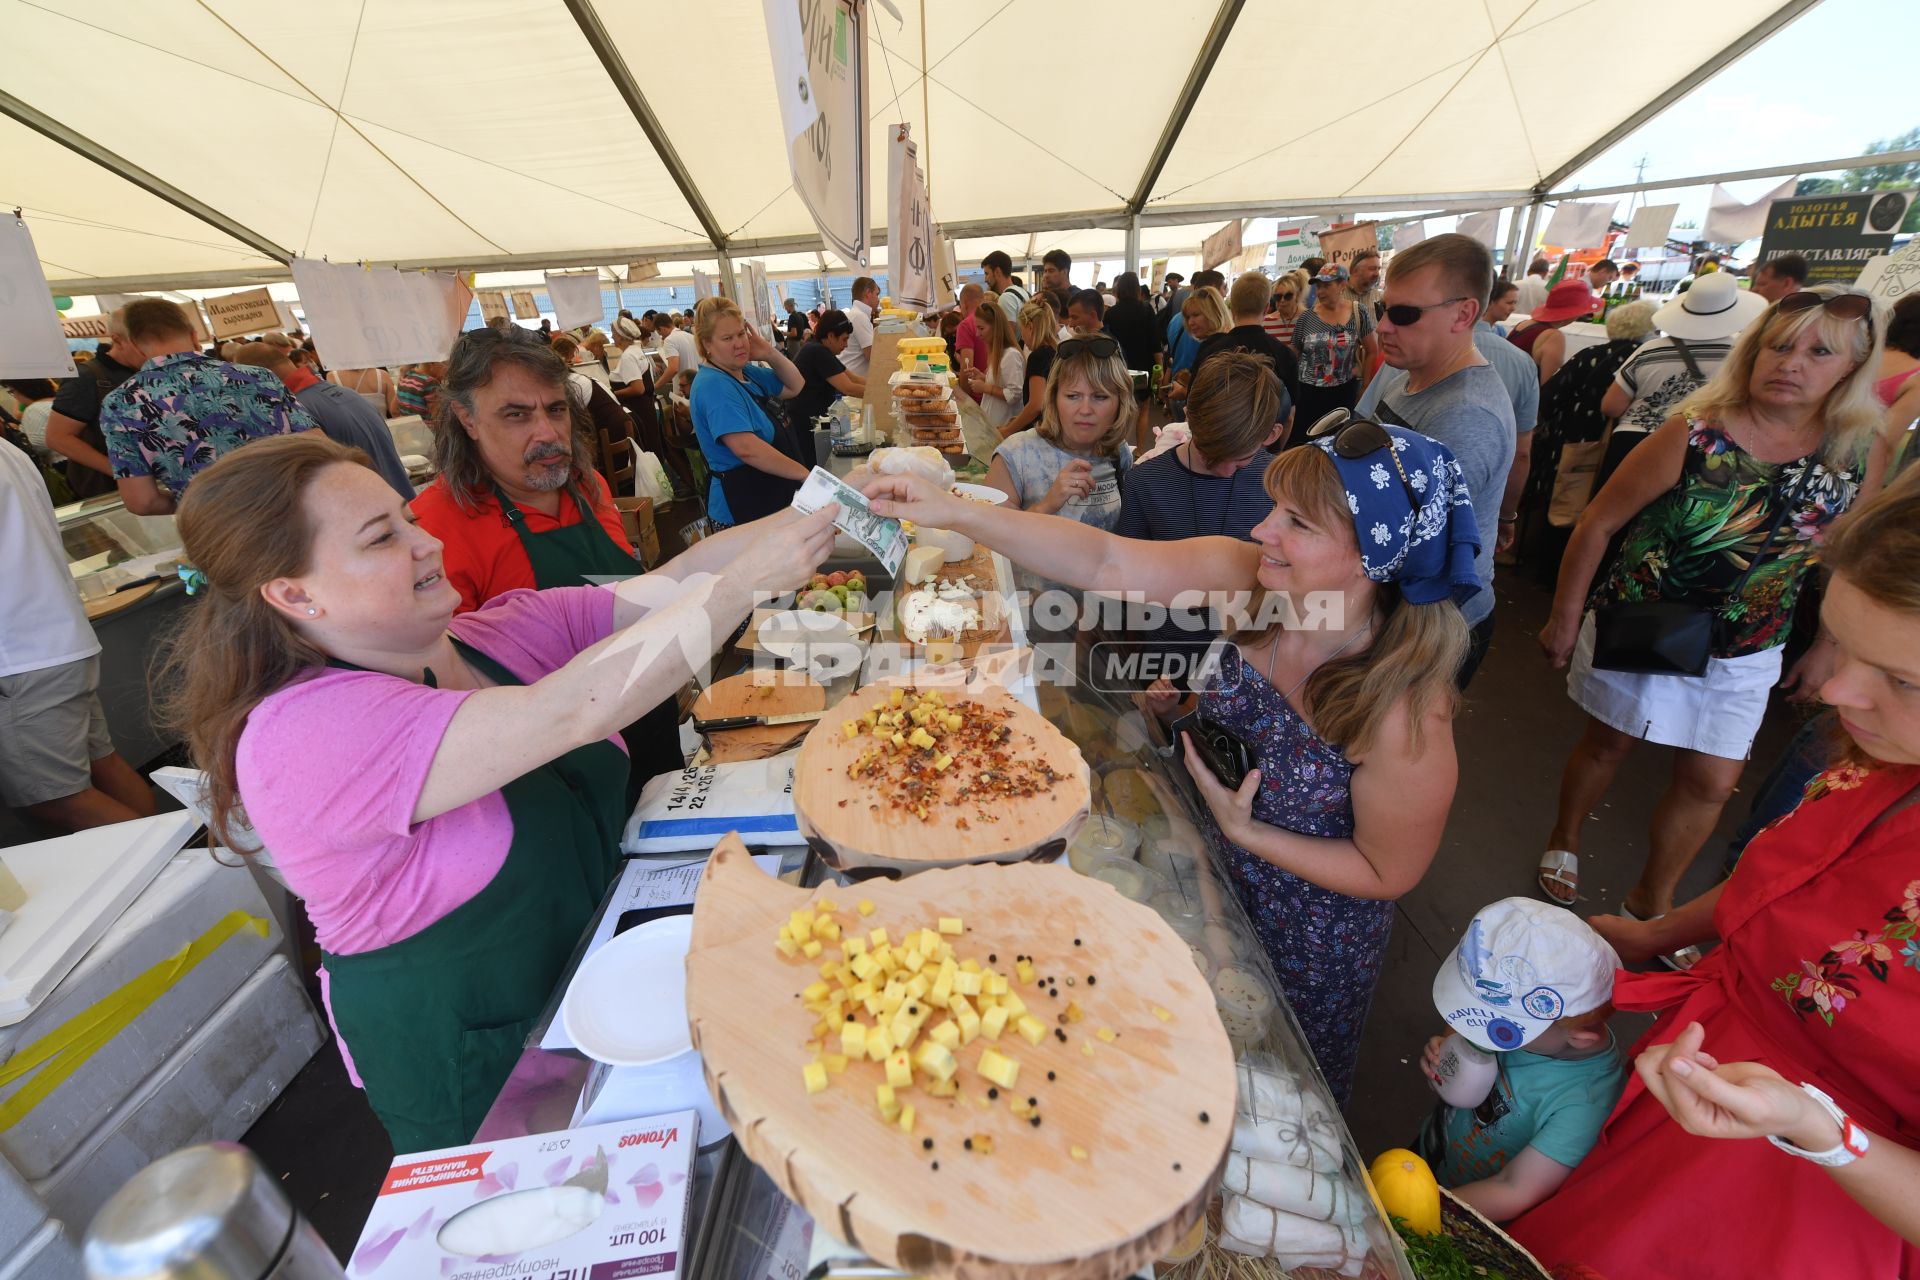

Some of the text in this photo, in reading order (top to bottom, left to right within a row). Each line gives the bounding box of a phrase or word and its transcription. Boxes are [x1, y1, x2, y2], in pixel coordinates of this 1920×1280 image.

[1790, 202, 1849, 214] ЗОЛОТАЯ
[1773, 212, 1858, 230] АДЫГЕЯ
[697, 774, 714, 789] 26
[688, 795, 707, 810] 22
[1466, 1018, 1488, 1028] CLU
[411, 1159, 468, 1177] МАНЖЕТЫ
[390, 1167, 480, 1189] ФОРМИРОВАНИЕ
[612, 1218, 657, 1233] упаковке
[608, 1227, 668, 1247] 100 шт.
